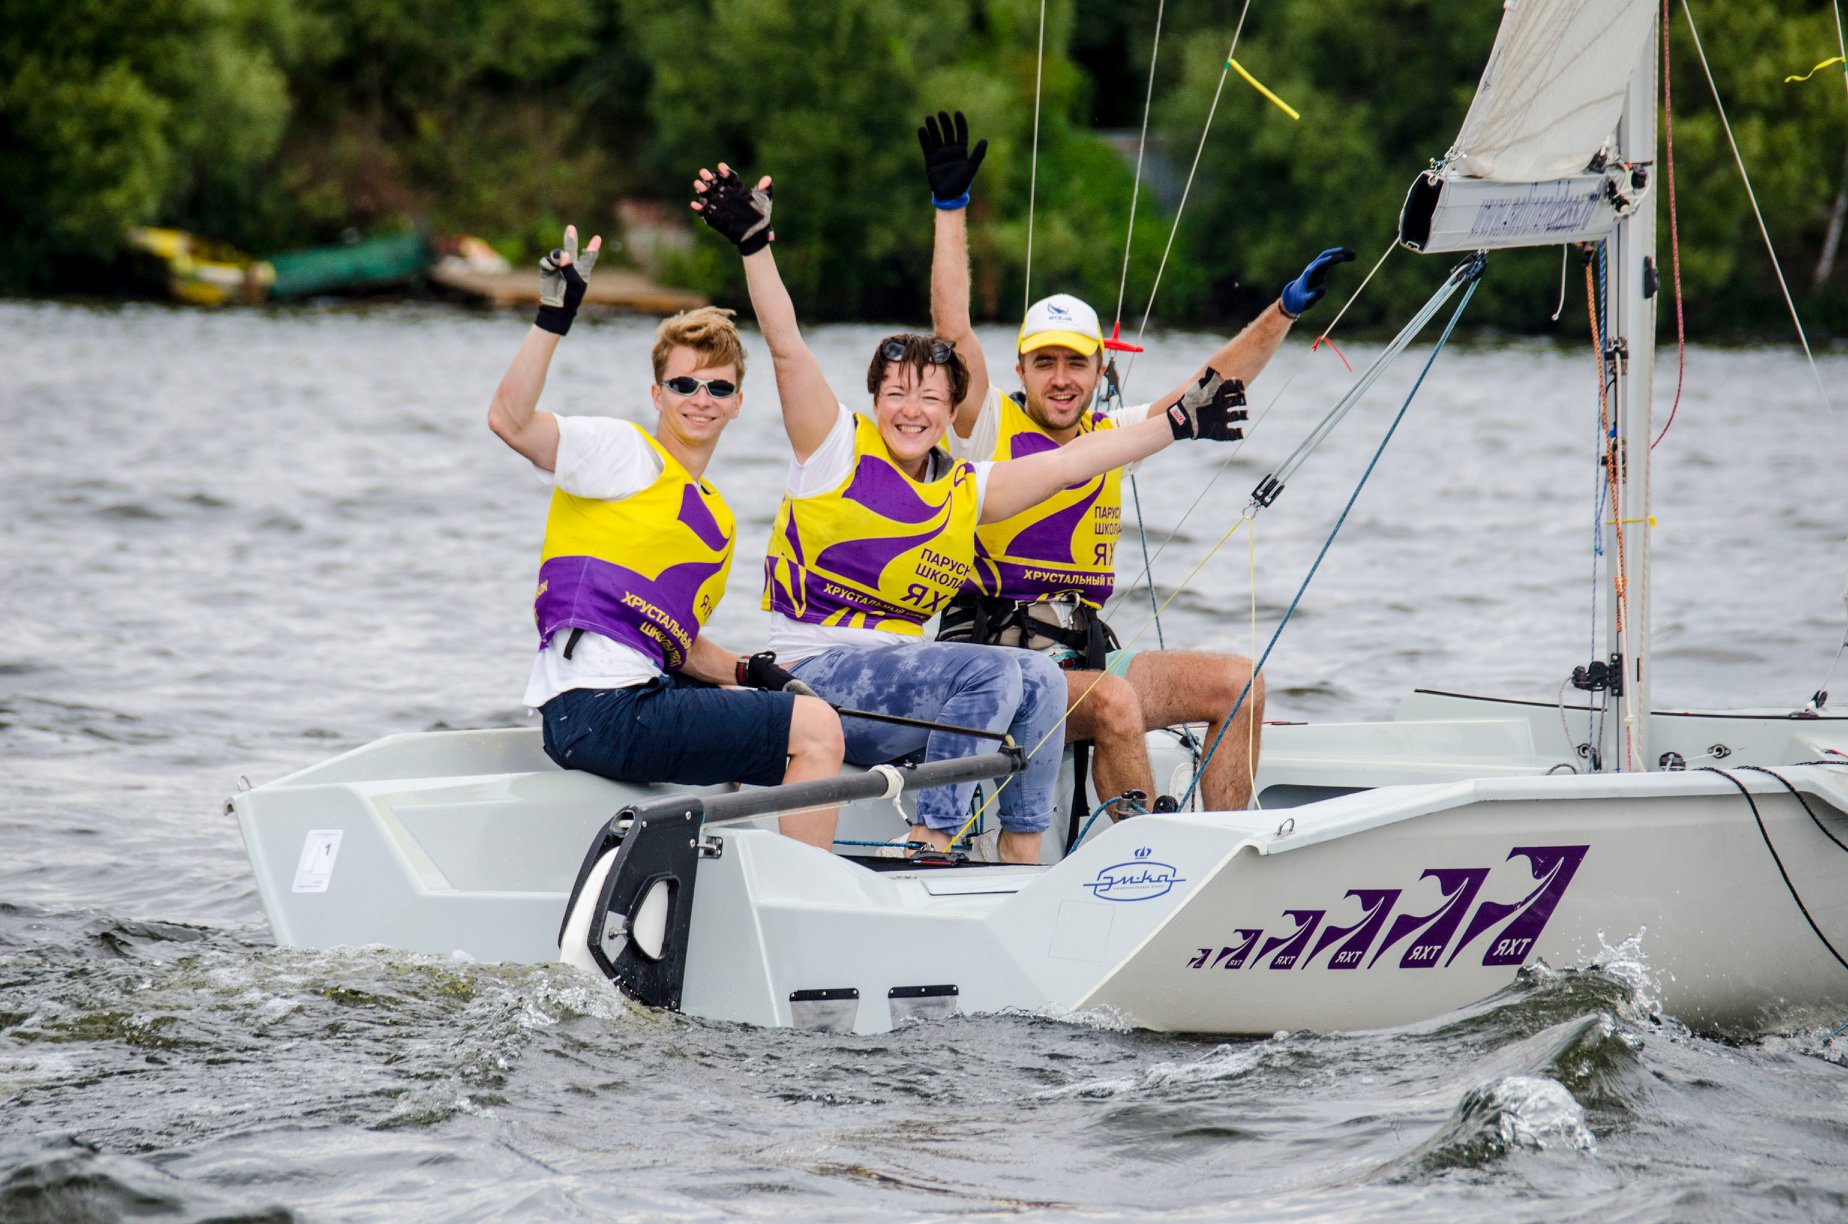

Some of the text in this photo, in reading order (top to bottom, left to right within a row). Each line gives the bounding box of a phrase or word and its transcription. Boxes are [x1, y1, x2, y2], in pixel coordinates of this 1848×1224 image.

[1023, 569, 1106, 586] ХРУСТАЛЬНЫЙ
[900, 583, 954, 612] ЯХ
[325, 843, 332, 856] 1
[1408, 945, 1442, 960] ЯХТ
[1492, 938, 1532, 956] ЯХТ
[1274, 956, 1296, 965] ЯХТ
[1335, 951, 1362, 963] ЯХТ
